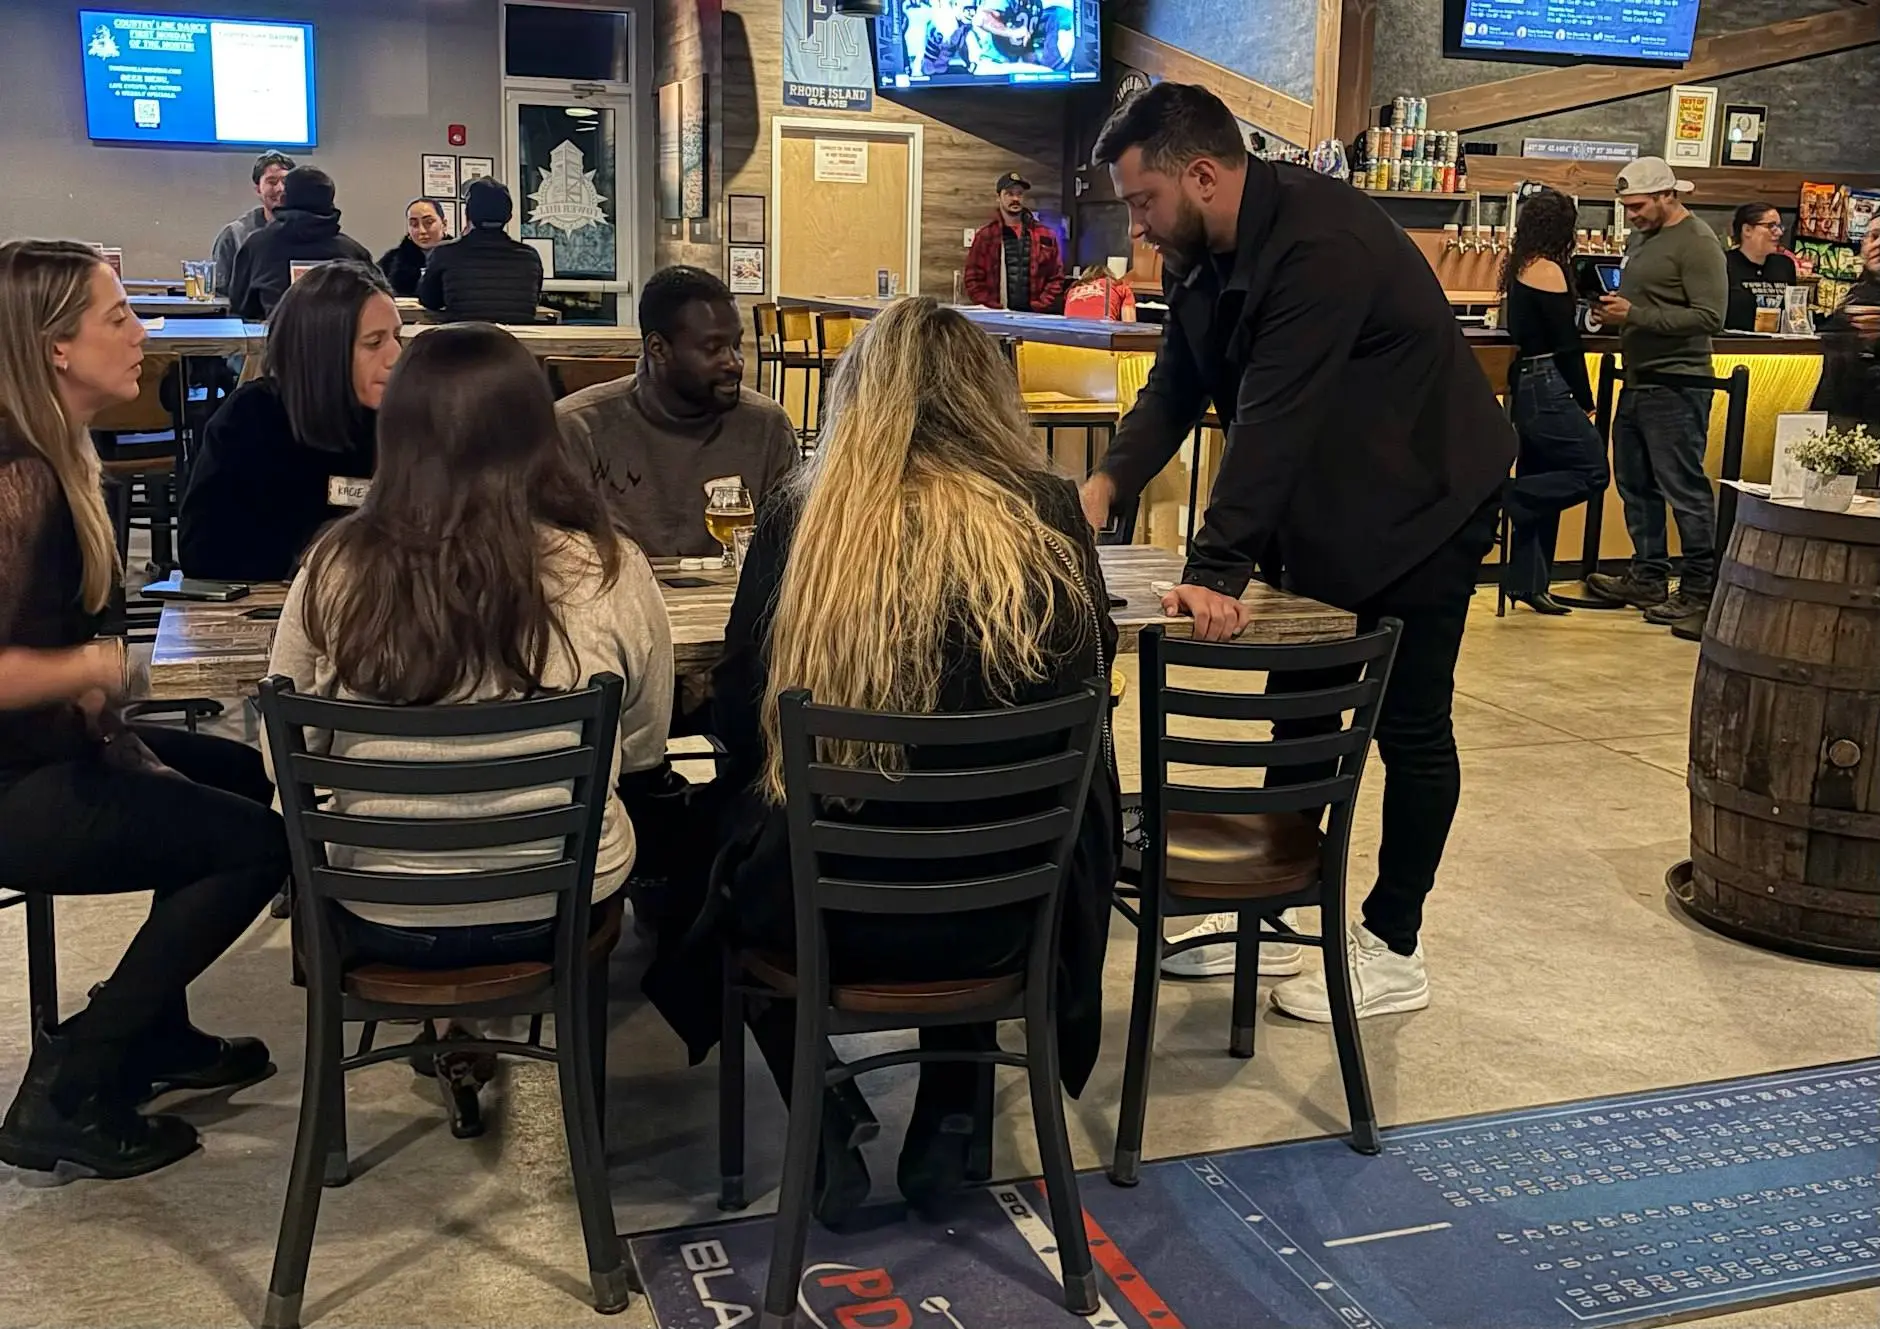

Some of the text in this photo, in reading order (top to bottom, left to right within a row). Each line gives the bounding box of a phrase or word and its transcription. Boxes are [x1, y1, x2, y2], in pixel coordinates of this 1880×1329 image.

[789, 84, 867, 101] RHODE ISLAND
[808, 97, 848, 108] RAMS
[1622, 1214, 1642, 1223] 46
[1645, 1210, 1667, 1218] 47
[1714, 1198, 1737, 1208] 50
[1756, 1226, 1778, 1235] 18
[1738, 1194, 1760, 1204] 51
[1780, 1222, 1802, 1231] 19
[1760, 1191, 1783, 1201] 52
[1801, 1216, 1825, 1227] 20
[1783, 1188, 1848, 1223] 53 13
[1806, 1184, 1872, 1219] 54 14
[1548, 1225, 1569, 1235] 43
[1572, 1221, 1594, 1231] 44
[1598, 1218, 1618, 1226] 45
[1635, 1245, 1656, 1254] 13
[1668, 1206, 1690, 1215] 48
[1709, 1232, 1730, 1242] 16
[1692, 1202, 1713, 1211] 49
[1733, 1229, 1755, 1237] 17
[1498, 1234, 1519, 1243] 41
[1523, 1230, 1544, 1240] 42
[1558, 1258, 1581, 1268] 10
